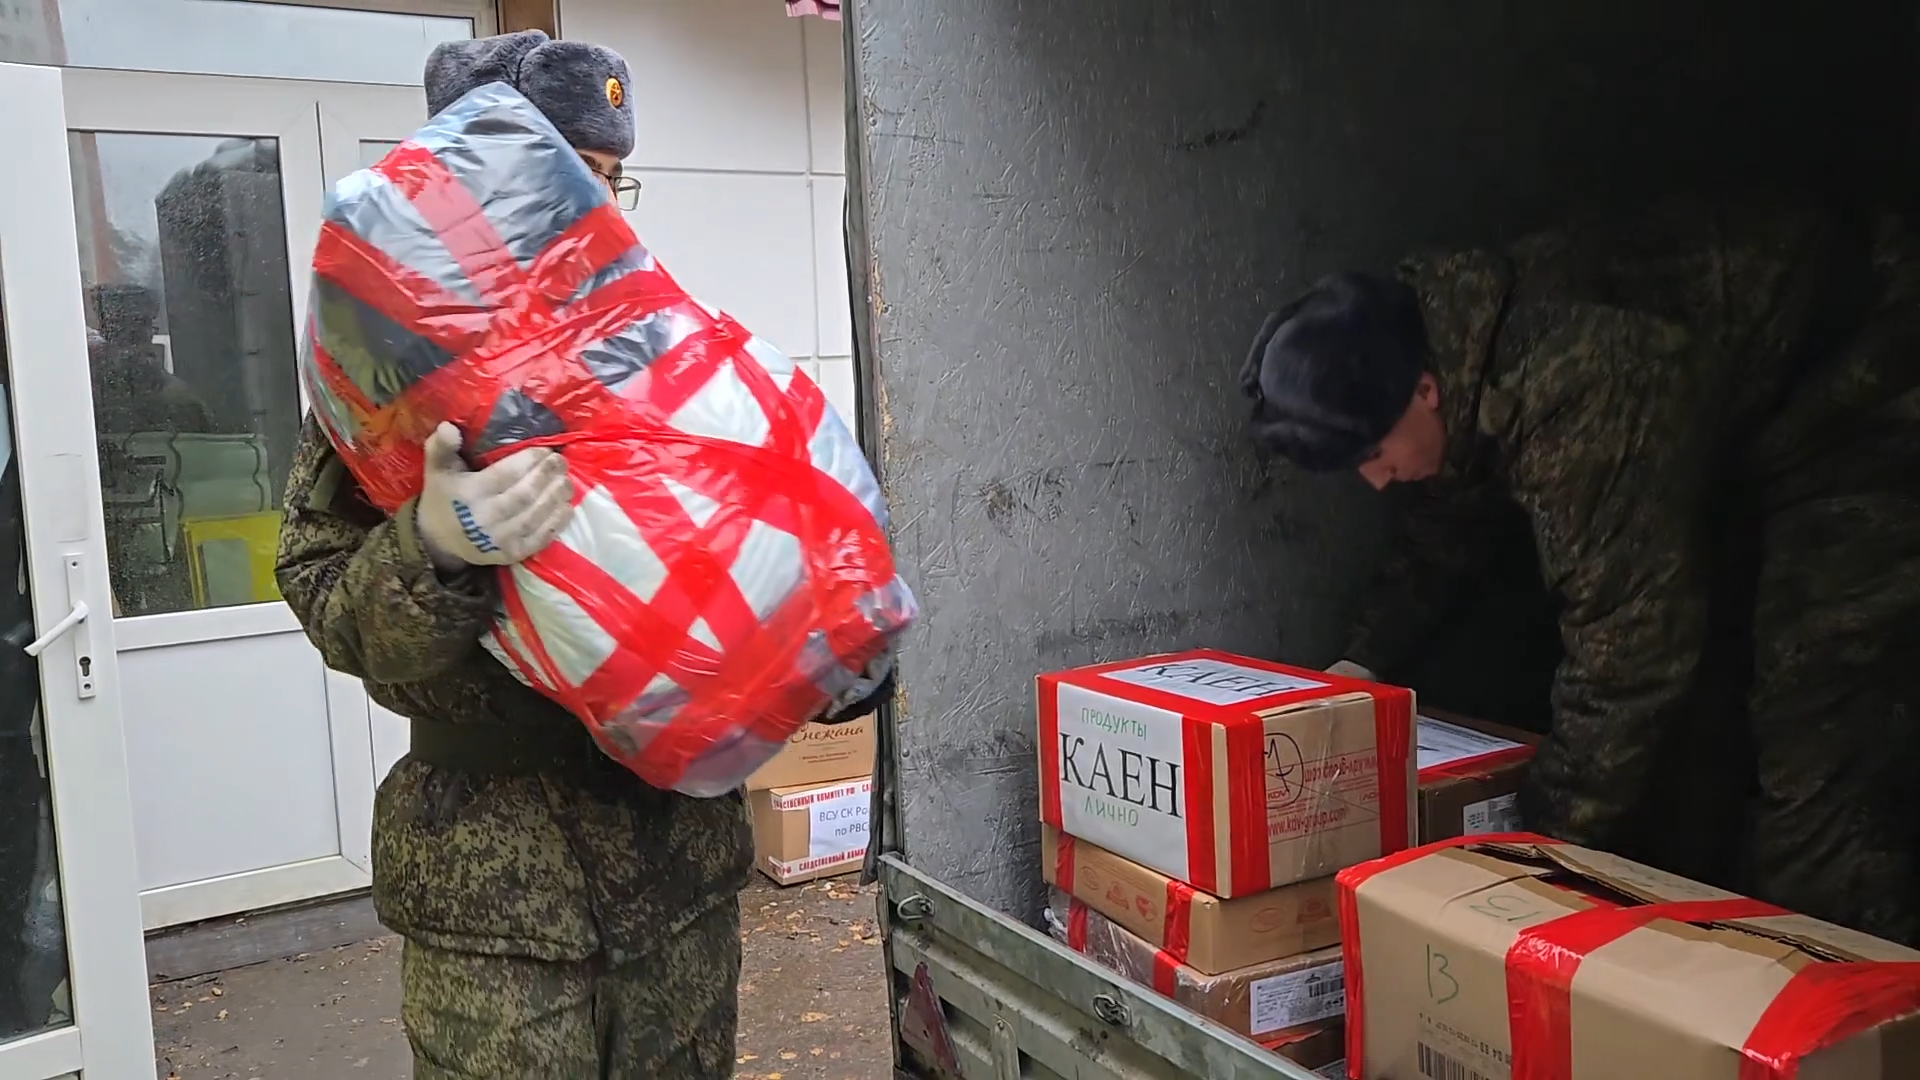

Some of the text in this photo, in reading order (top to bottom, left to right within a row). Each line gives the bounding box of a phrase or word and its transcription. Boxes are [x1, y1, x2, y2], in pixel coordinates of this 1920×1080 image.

[1081, 707, 1147, 741] ПРОДУКТЫ
[1059, 731, 1183, 819] КАЕН
[819, 810, 838, 822] ВСУ
[840, 807, 853, 819] СК
[1084, 795, 1139, 827] ЛИЧНО
[835, 827, 847, 837] по
